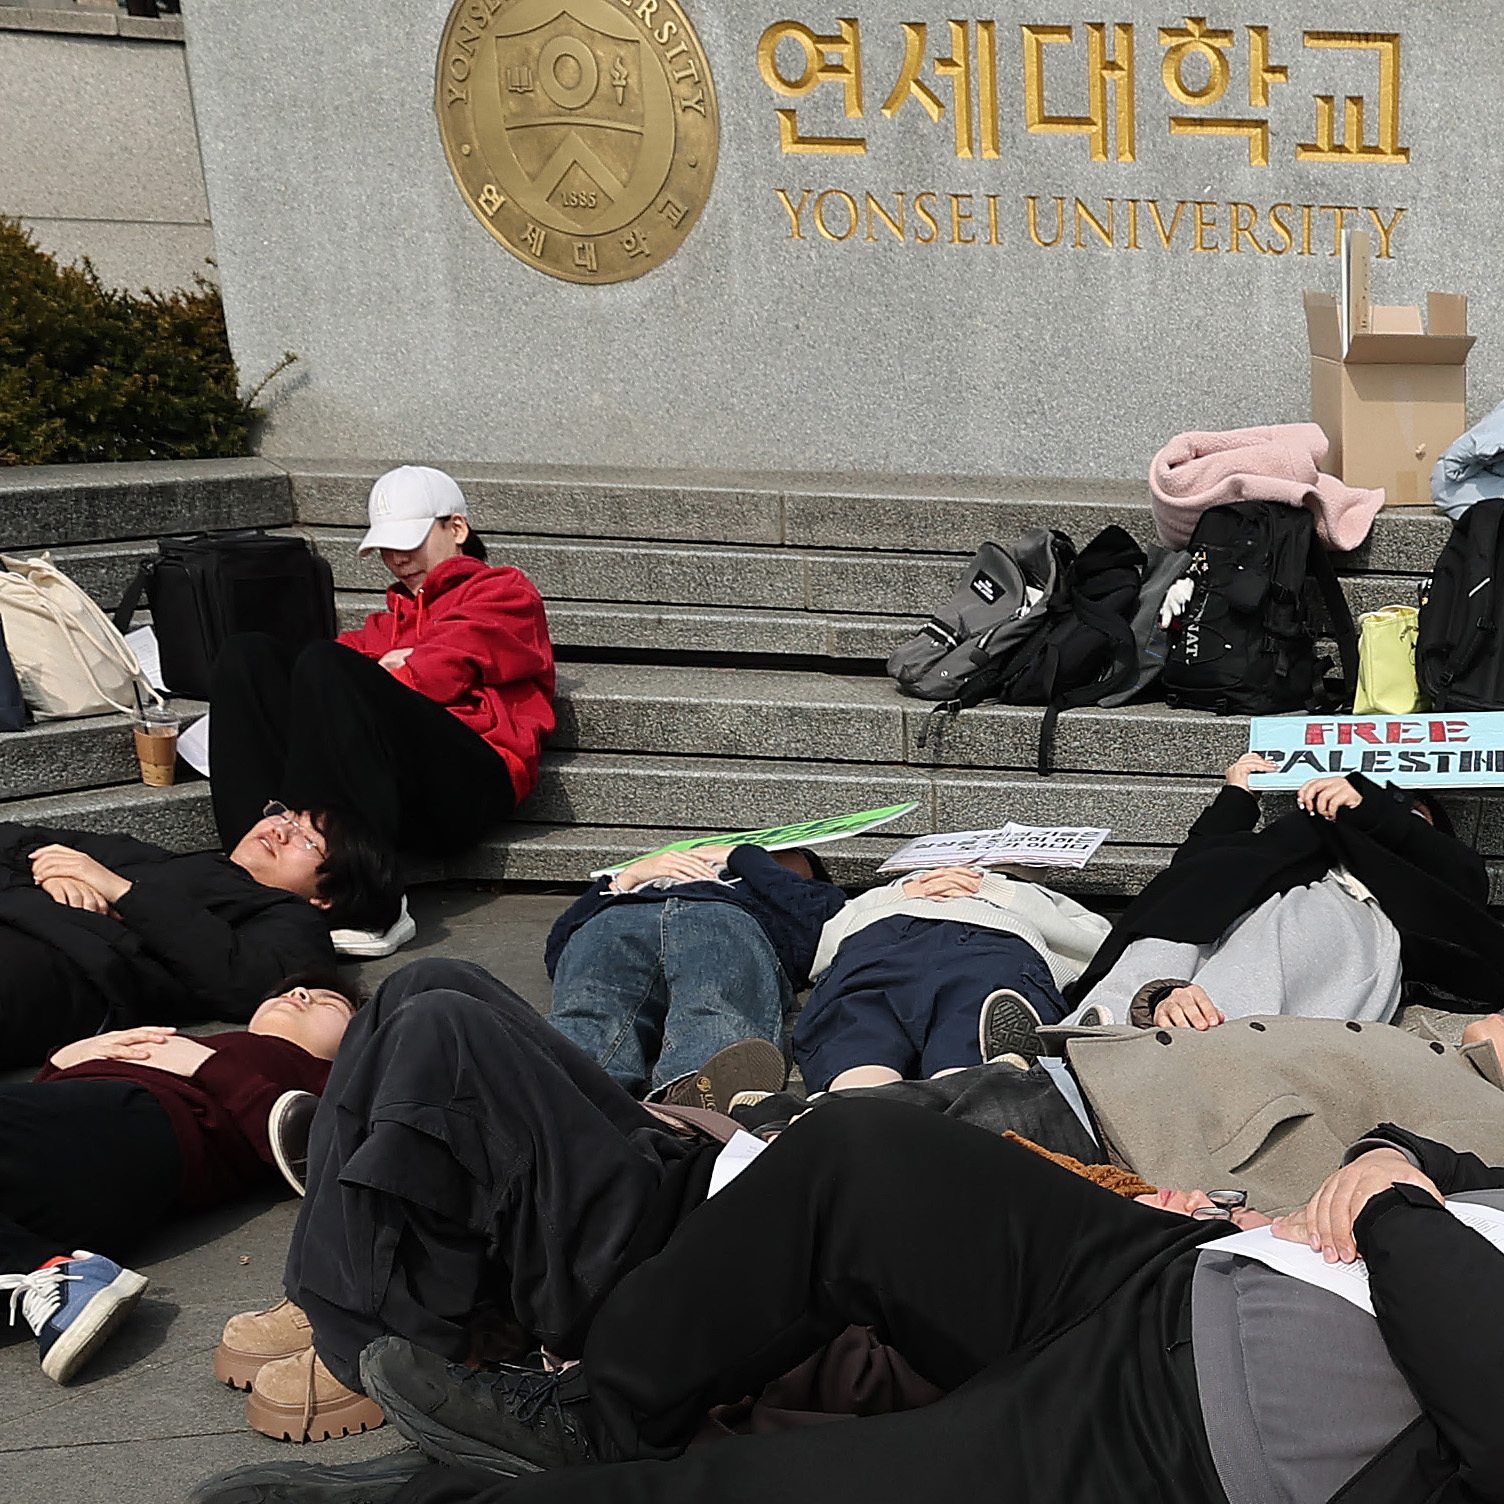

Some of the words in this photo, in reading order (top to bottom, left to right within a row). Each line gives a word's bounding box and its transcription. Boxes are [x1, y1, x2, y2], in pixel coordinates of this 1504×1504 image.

[620, 0, 706, 118] RSITY
[757, 18, 1410, 166] 연세대학교
[773, 188, 1004, 246] YONSEI
[1025, 196, 1408, 260] UNIVERSITY
[1304, 720, 1472, 745] FREE
